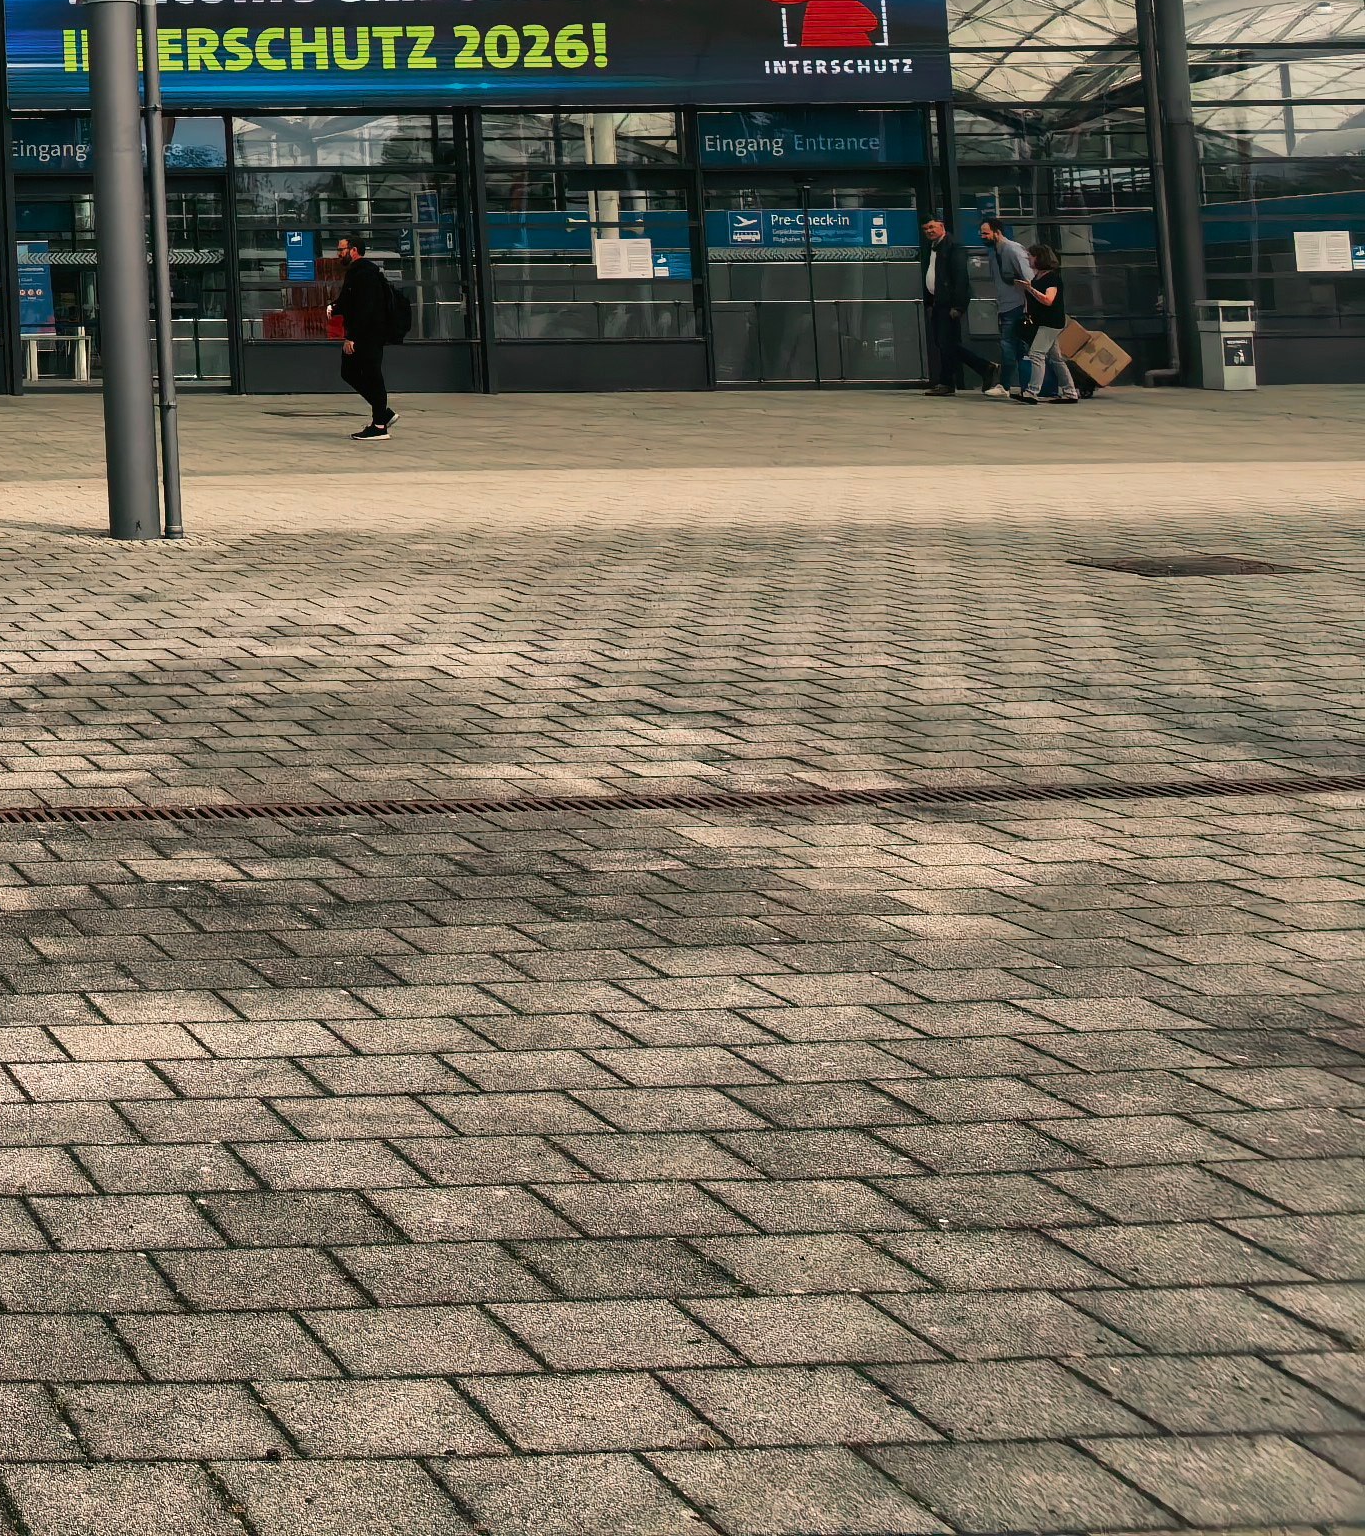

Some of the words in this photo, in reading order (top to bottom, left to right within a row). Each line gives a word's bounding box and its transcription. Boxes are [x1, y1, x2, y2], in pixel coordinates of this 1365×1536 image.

[62, 24, 437, 72] IERSCHUTZ
[453, 22, 608, 69] 2026!
[764, 58, 914, 75] INTERSCHUTZ
[11, 139, 89, 162] Eingang
[704, 134, 784, 157] Eingang
[794, 134, 880, 151] Entrance
